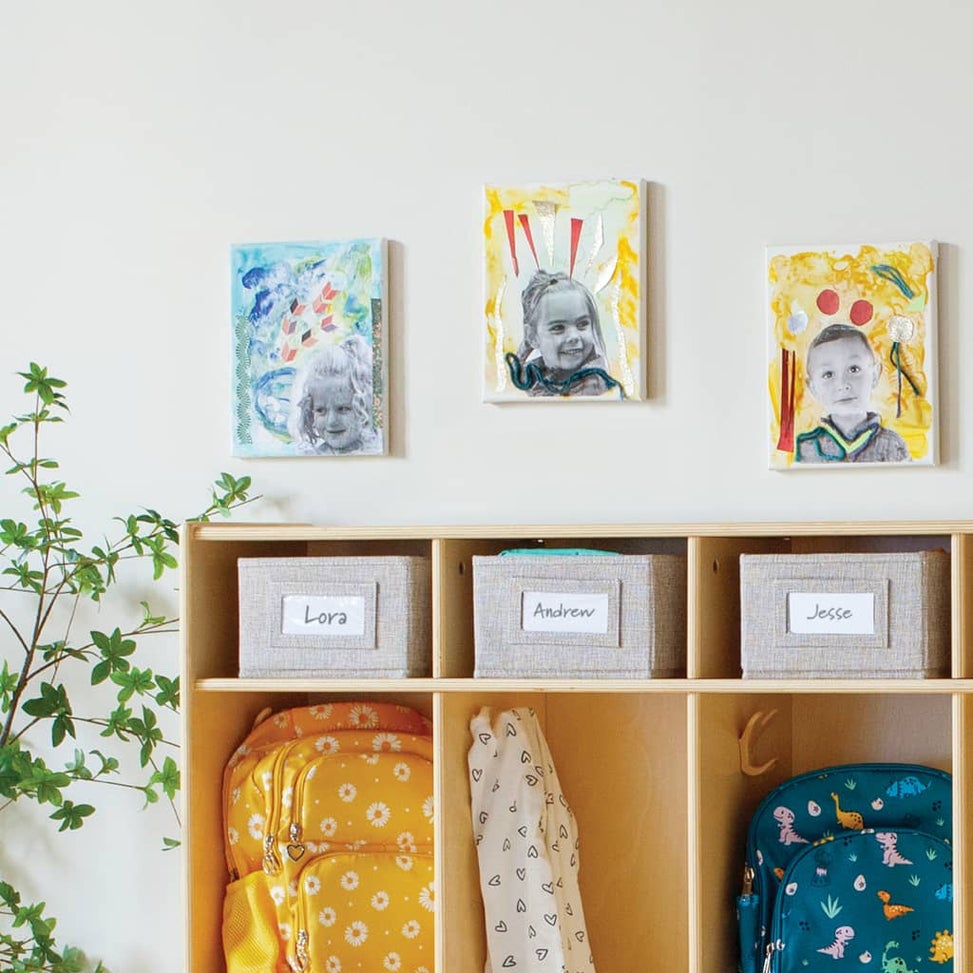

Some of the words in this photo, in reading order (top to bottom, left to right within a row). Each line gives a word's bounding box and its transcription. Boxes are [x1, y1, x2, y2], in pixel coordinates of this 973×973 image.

[304, 605, 348, 625] Lora
[533, 602, 595, 619] Andrew
[806, 604, 853, 621] Jesse
